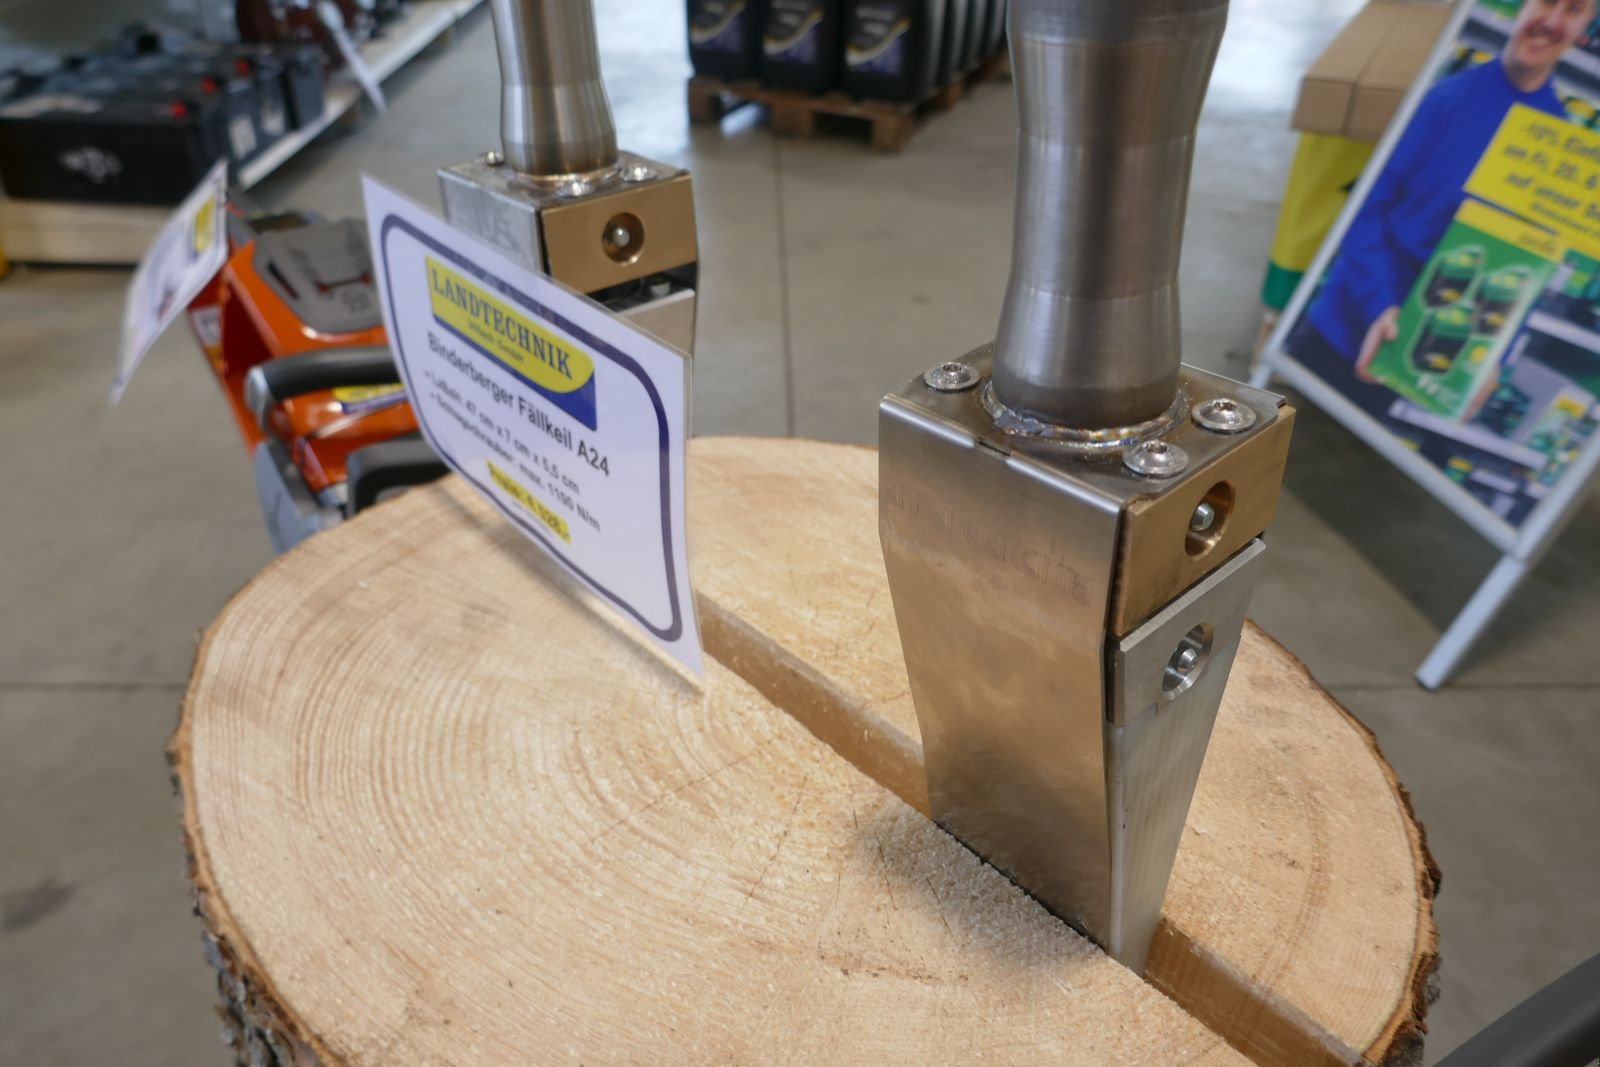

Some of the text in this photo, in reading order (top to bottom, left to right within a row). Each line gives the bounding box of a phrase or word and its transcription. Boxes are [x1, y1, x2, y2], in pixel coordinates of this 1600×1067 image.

[431, 267, 573, 380] LANDTECHNIK
[428, 330, 515, 408] Binderberger
[517, 395, 573, 451] Fällkeil
[577, 439, 611, 477] A24
[479, 411, 495, 430] cm
[513, 438, 531, 457] cm
[533, 453, 540, 465] x
[542, 456, 560, 480] 5,5
[561, 473, 580, 496] cm
[547, 482, 574, 511] 1100
